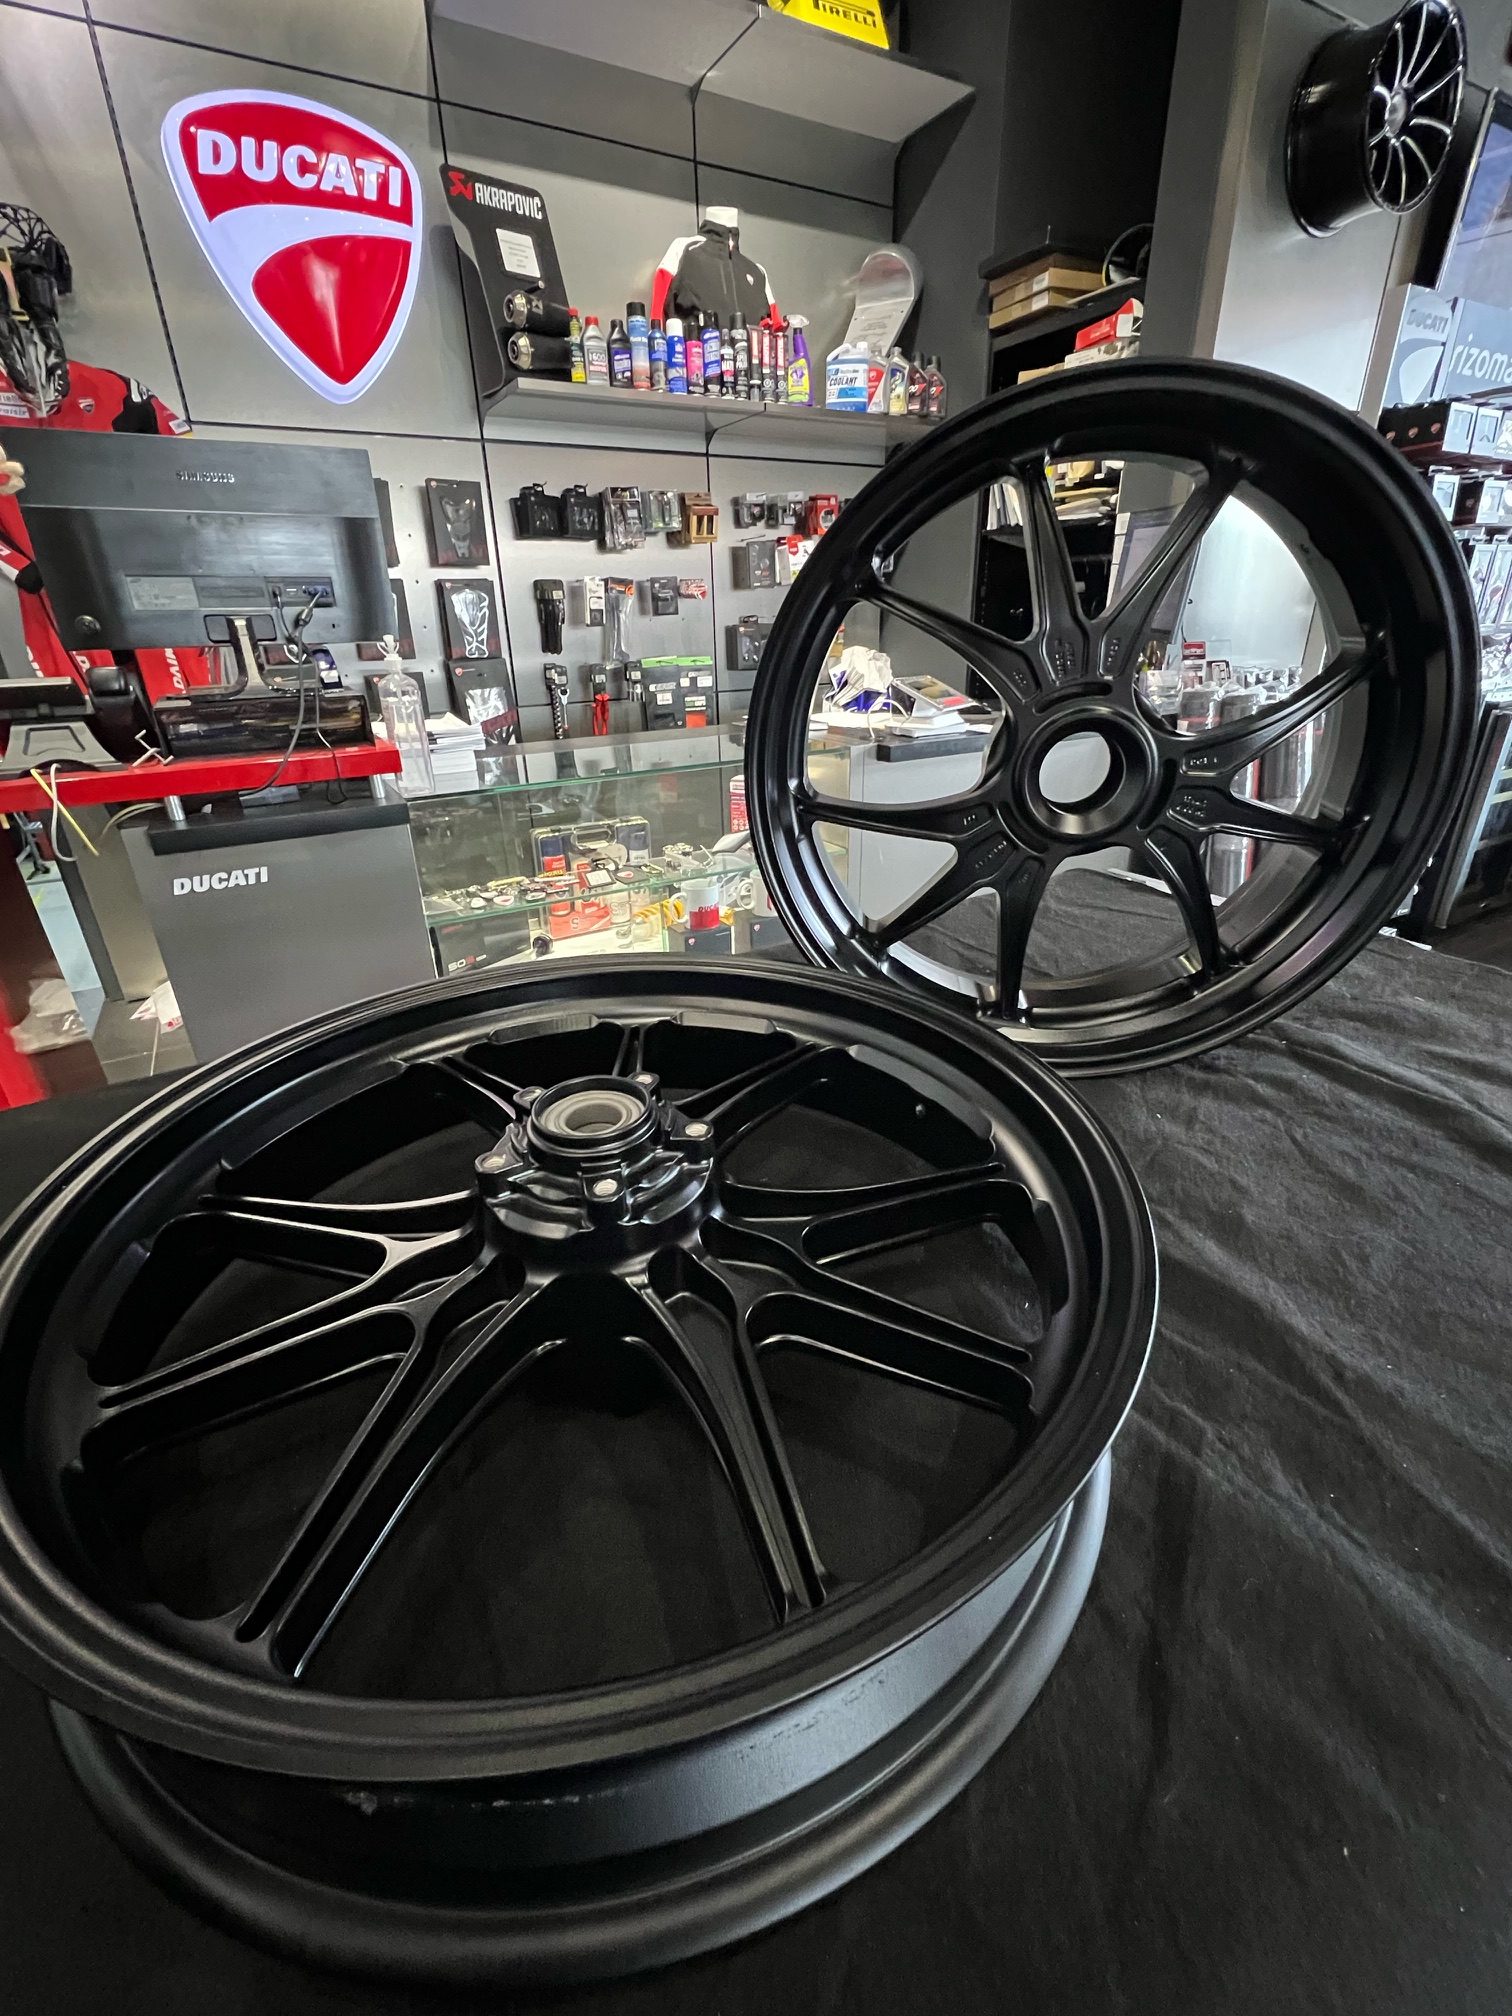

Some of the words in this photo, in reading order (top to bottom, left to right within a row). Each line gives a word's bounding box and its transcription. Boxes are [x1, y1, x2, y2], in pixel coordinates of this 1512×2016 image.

[196, 128, 402, 208] DUCATI
[1406, 309, 1449, 334] DUCATI
[829, 376, 858, 387] COOLANT
[173, 866, 269, 896] DUCATI
